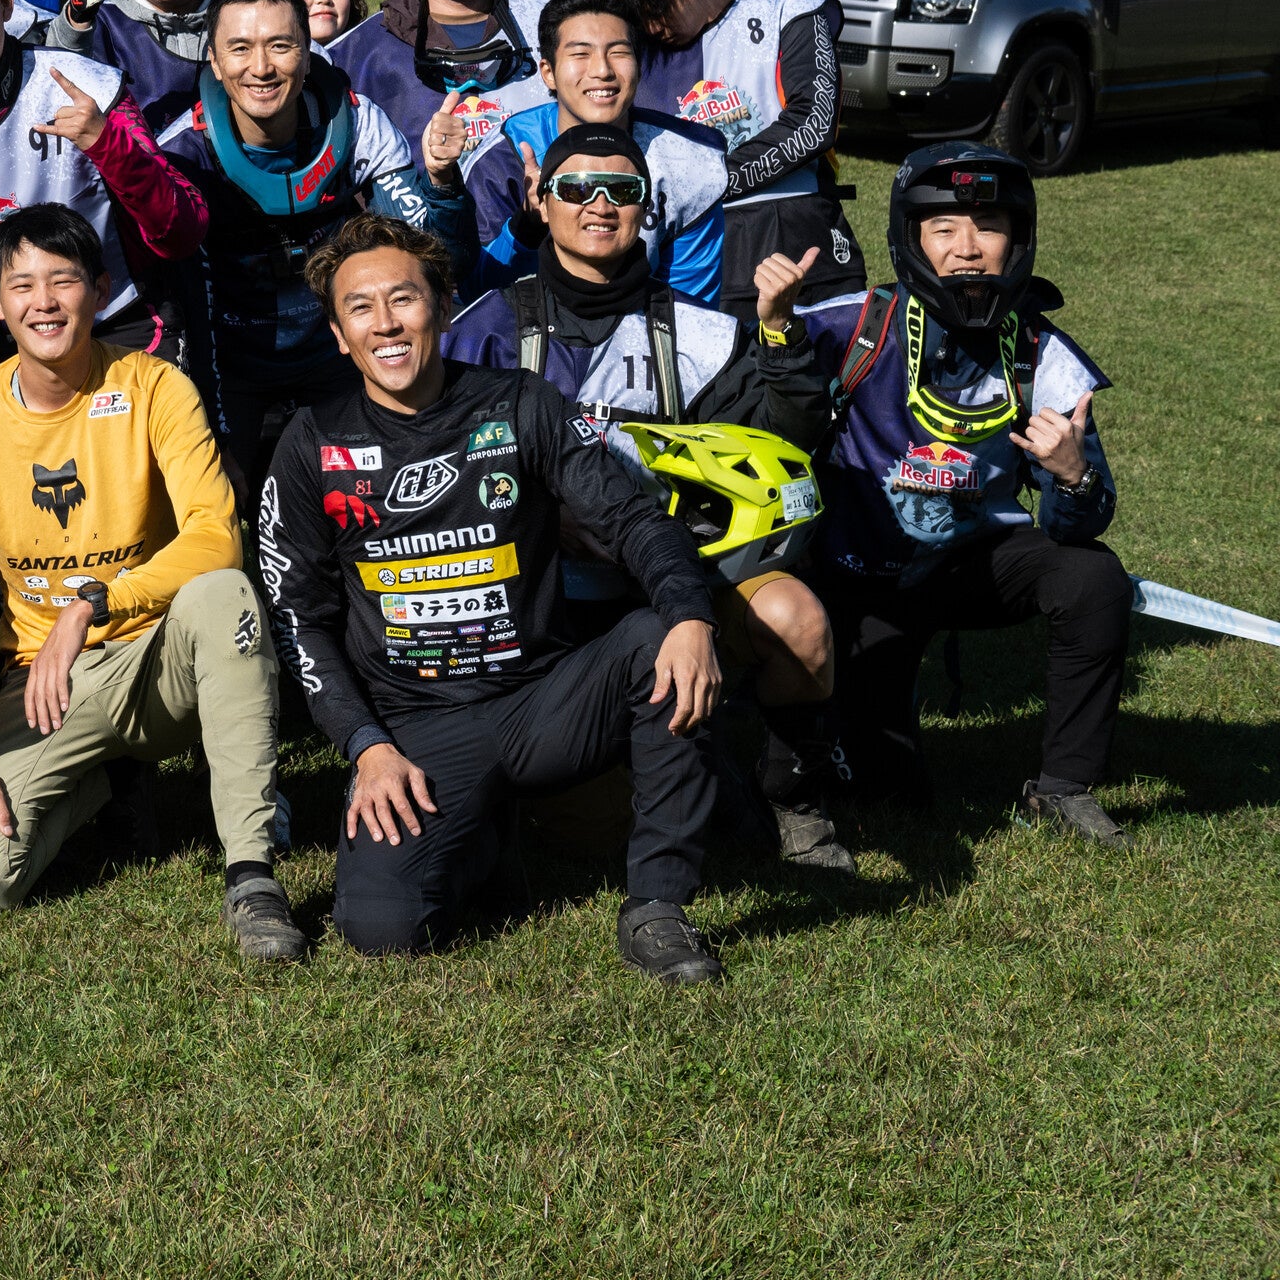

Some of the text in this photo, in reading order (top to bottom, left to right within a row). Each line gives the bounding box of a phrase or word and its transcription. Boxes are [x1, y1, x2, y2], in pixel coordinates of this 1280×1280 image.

[746, 18, 765, 45] 8
[707, 90, 741, 117] Bull
[740, 147, 784, 187] THE
[785, 74, 837, 163] WORLD'S
[294, 144, 338, 202] LEATT
[857, 337, 875, 350] evoc
[907, 304, 922, 386] 100%
[94, 394, 123, 409] DF
[90, 404, 129, 418] DIRTFREAK
[361, 452, 376, 466] in
[466, 445, 518, 462] CORPORATION
[900, 464, 979, 491] Red Bull
[355, 479, 373, 495] 81
[489, 498, 513, 511] dojo
[364, 523, 497, 558] SHIMANO
[7, 538, 146, 571] SANTA CRUZ
[397, 556, 496, 584] STRIDER
[410, 589, 507, 617] マテラの森
[387, 628, 409, 637] MAVIC
[406, 649, 443, 657] AEONBIKE
[457, 656, 481, 665] SARIS
[448, 666, 477, 676] MARSH
